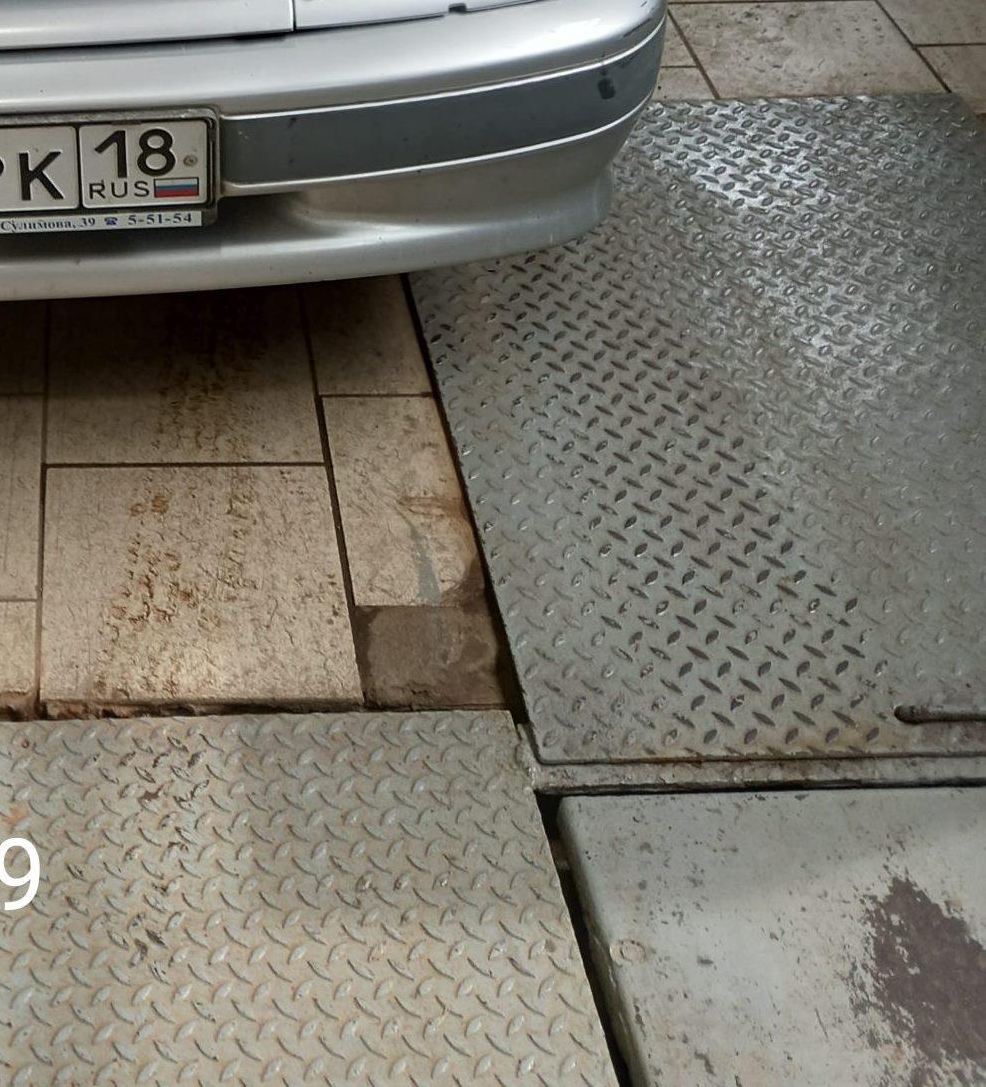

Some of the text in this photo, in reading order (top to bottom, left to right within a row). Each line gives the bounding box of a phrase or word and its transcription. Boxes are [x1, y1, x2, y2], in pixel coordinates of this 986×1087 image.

[94, 128, 175, 179] 18
[89, 179, 149, 201] RUS
[127, 212, 193, 226] 5-51-54
